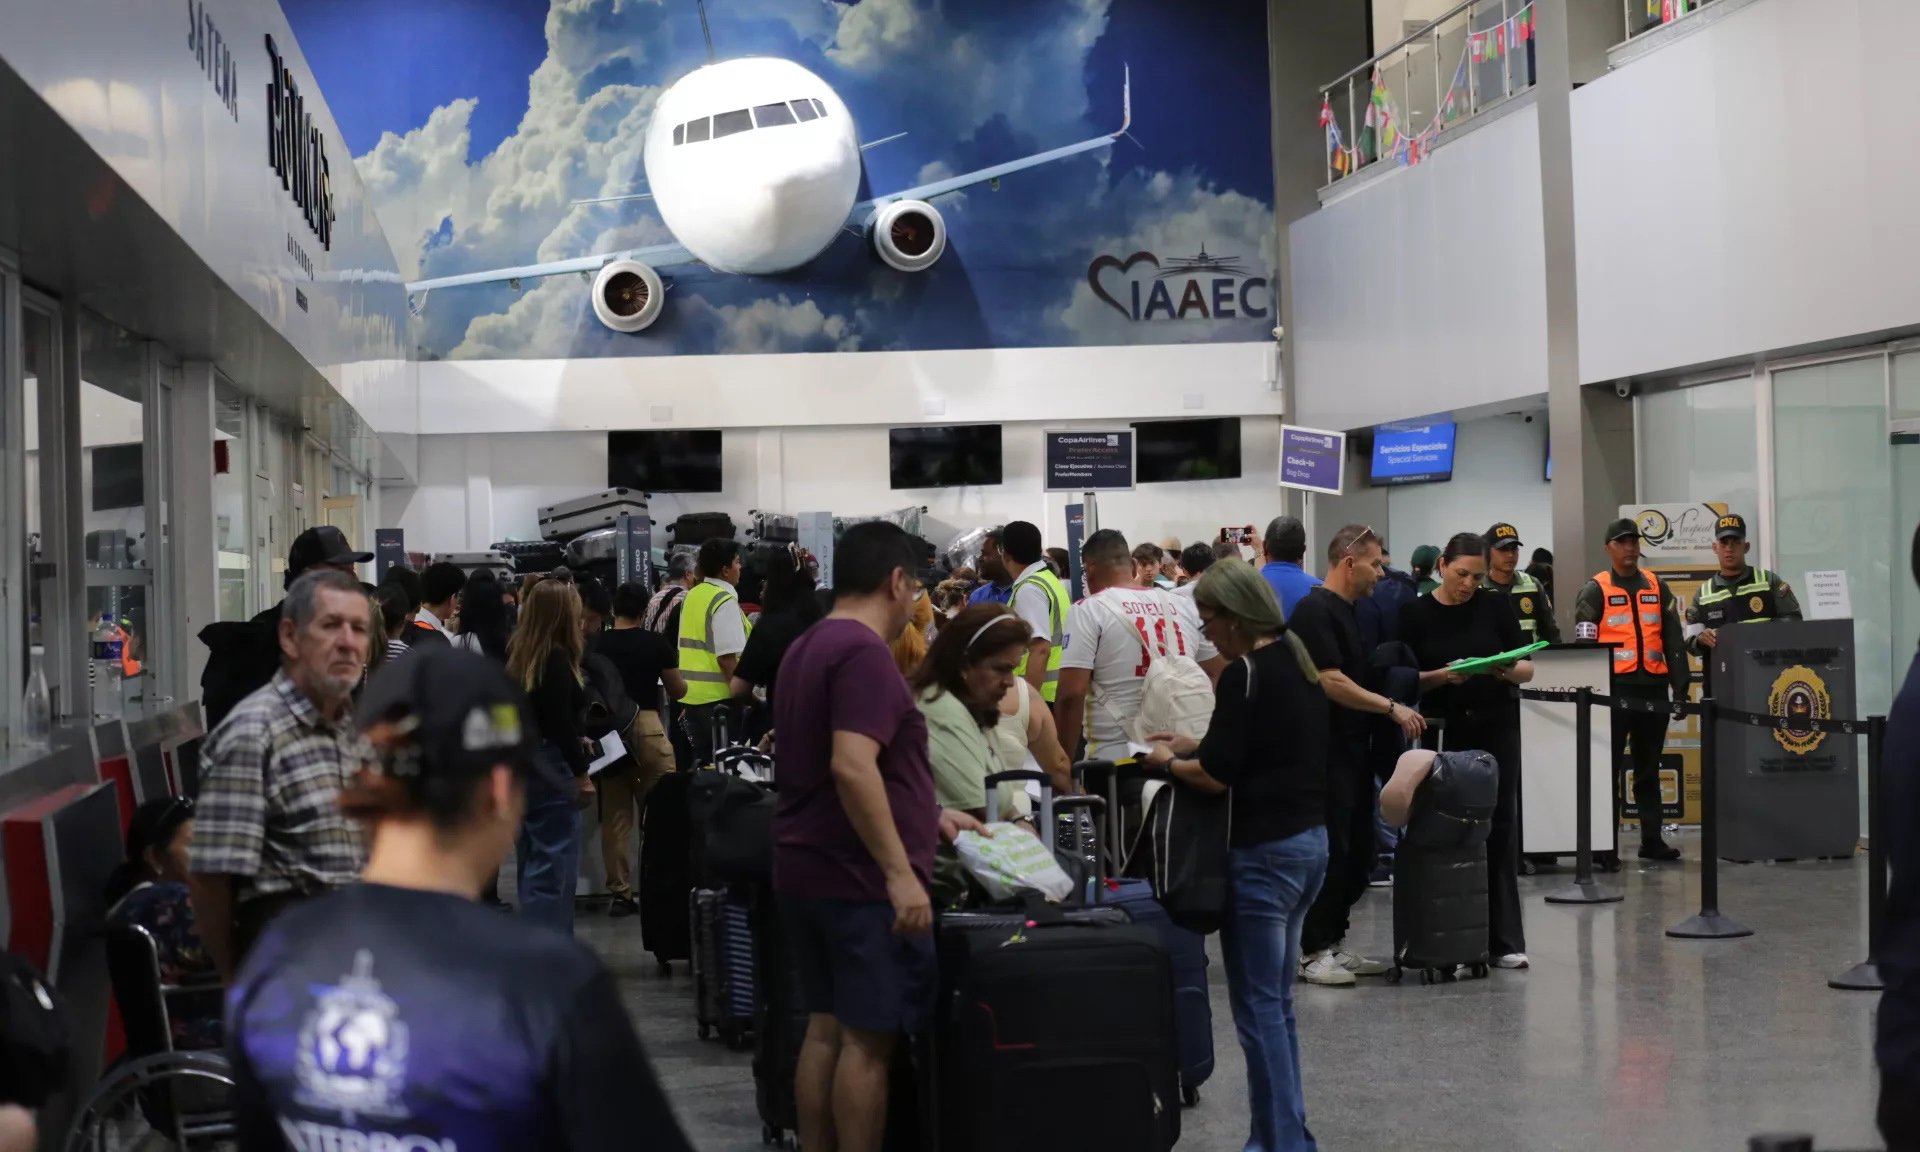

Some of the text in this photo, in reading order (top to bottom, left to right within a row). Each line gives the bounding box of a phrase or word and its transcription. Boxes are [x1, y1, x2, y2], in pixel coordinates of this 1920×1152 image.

[1131, 277, 1267, 321] IAAEC
[1719, 517, 1740, 528] CNA
[1495, 526, 1517, 538] CNA
